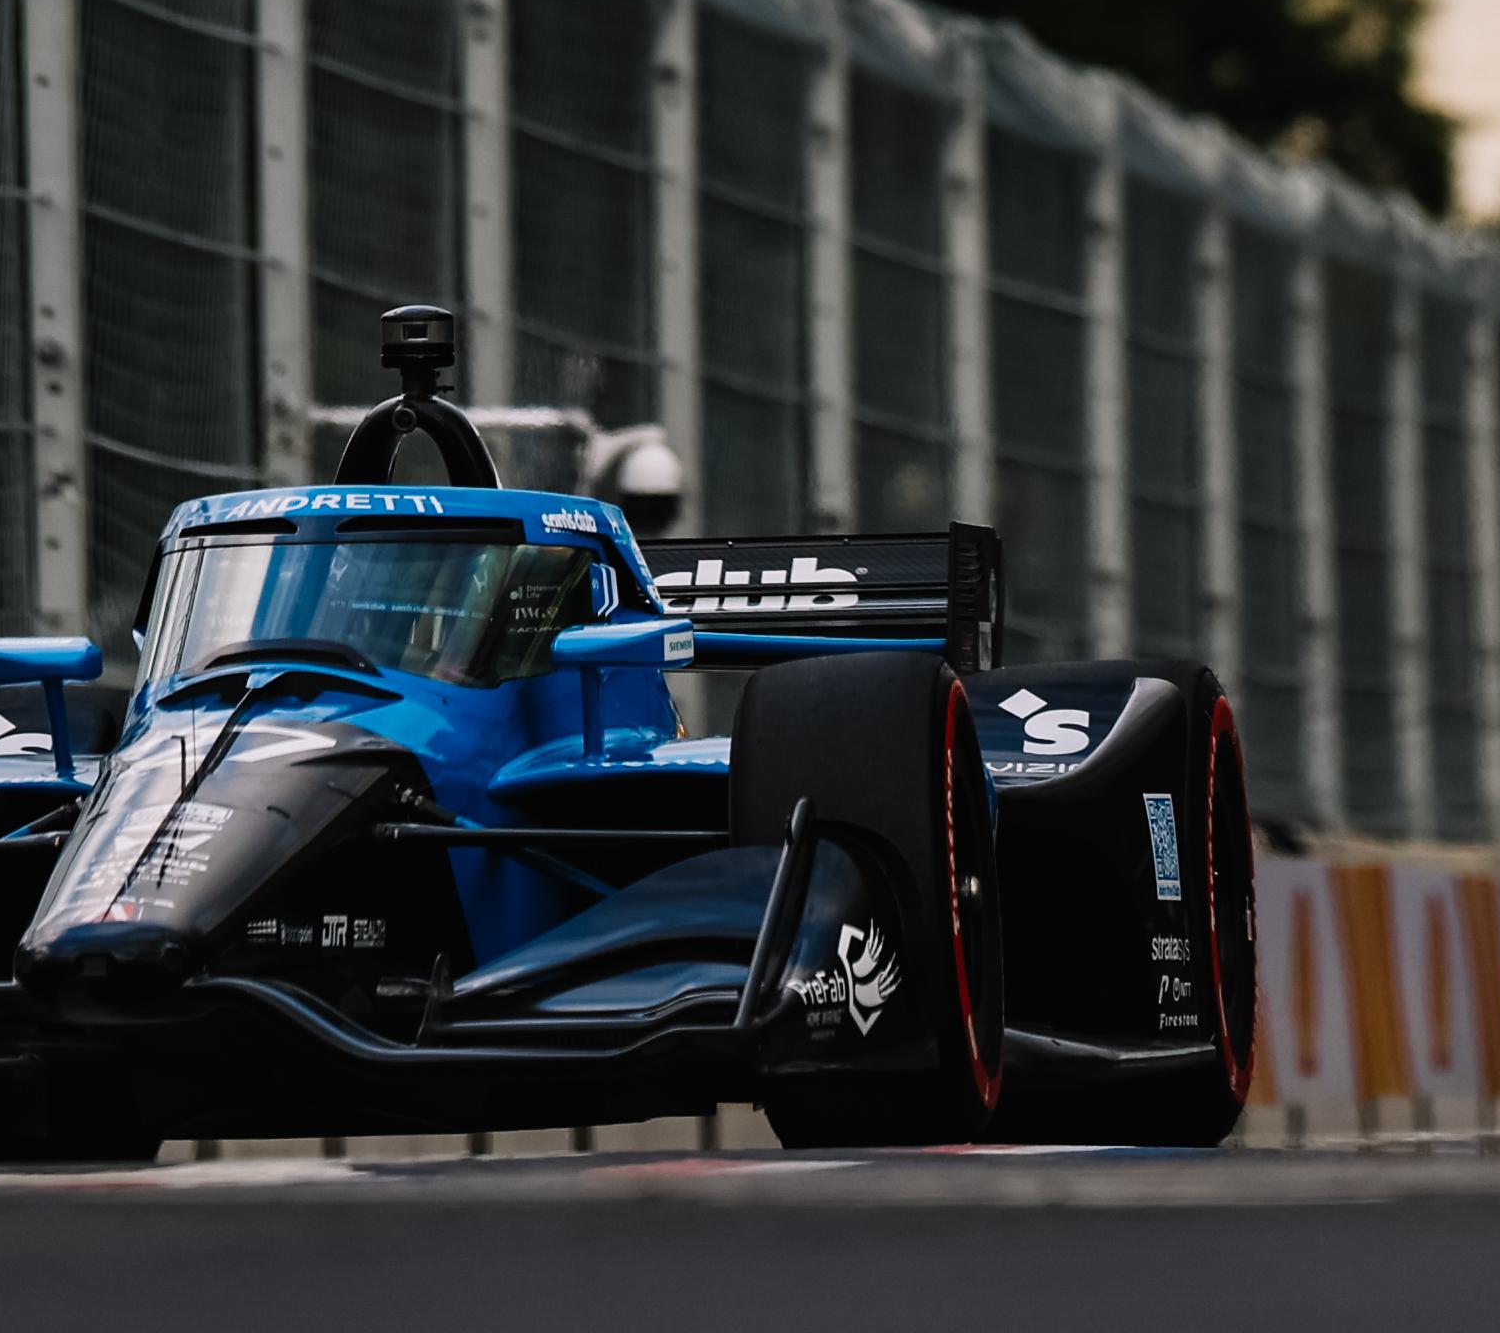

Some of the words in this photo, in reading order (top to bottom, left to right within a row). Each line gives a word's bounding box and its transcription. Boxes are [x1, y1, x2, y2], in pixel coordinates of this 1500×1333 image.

[225, 493, 445, 520] ANDRETTI
[1152, 933, 1191, 965] stratasys
[786, 969, 846, 1005] PreFab
[1159, 1013, 1198, 1029] Firestone
